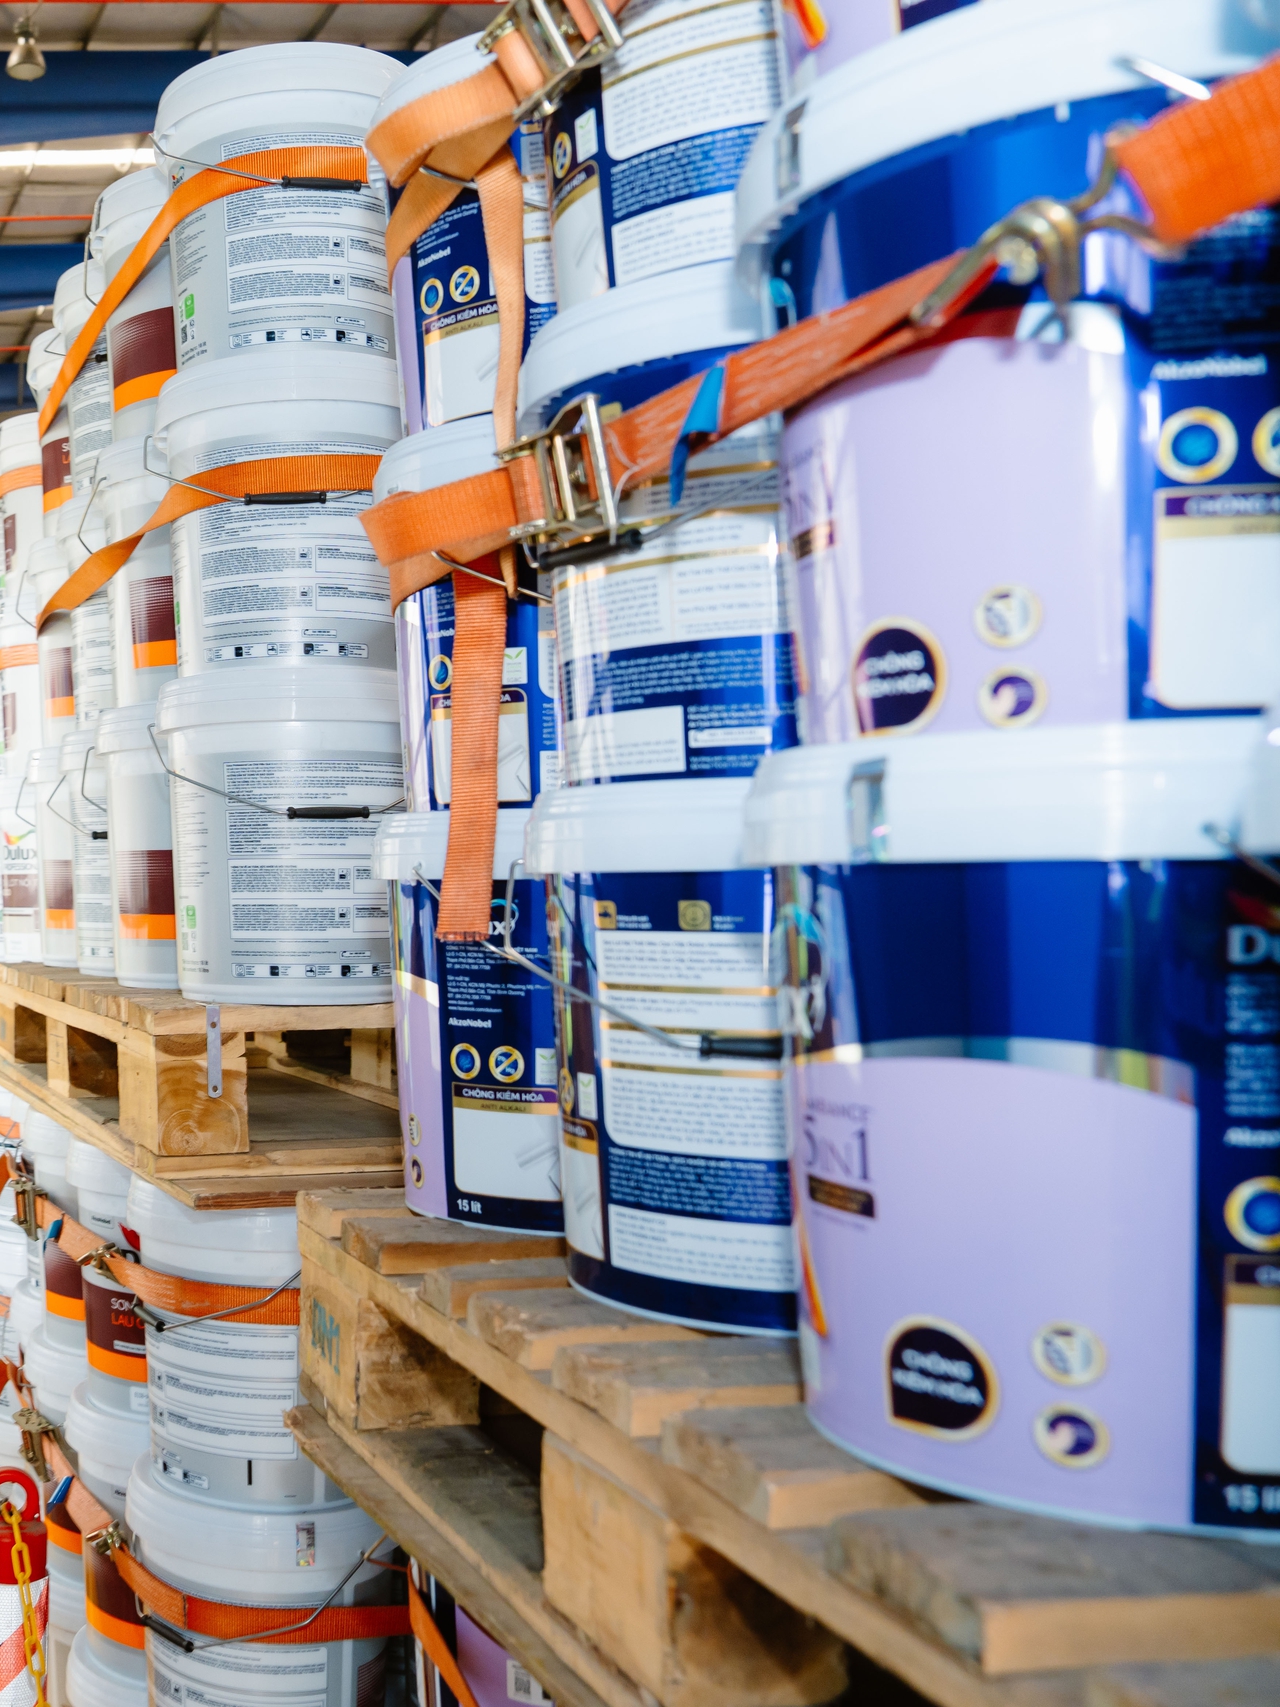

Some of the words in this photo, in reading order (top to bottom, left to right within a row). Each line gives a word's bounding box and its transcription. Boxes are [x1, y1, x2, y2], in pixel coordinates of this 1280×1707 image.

[418, 246, 451, 269] AkzoNobel
[426, 628, 455, 640] AkzoNob
[448, 1017, 492, 1028] AkzoNobel
[456, 1198, 470, 1213] 15
[471, 1200, 483, 1215] lít
[111, 1312, 135, 1328] LAU
